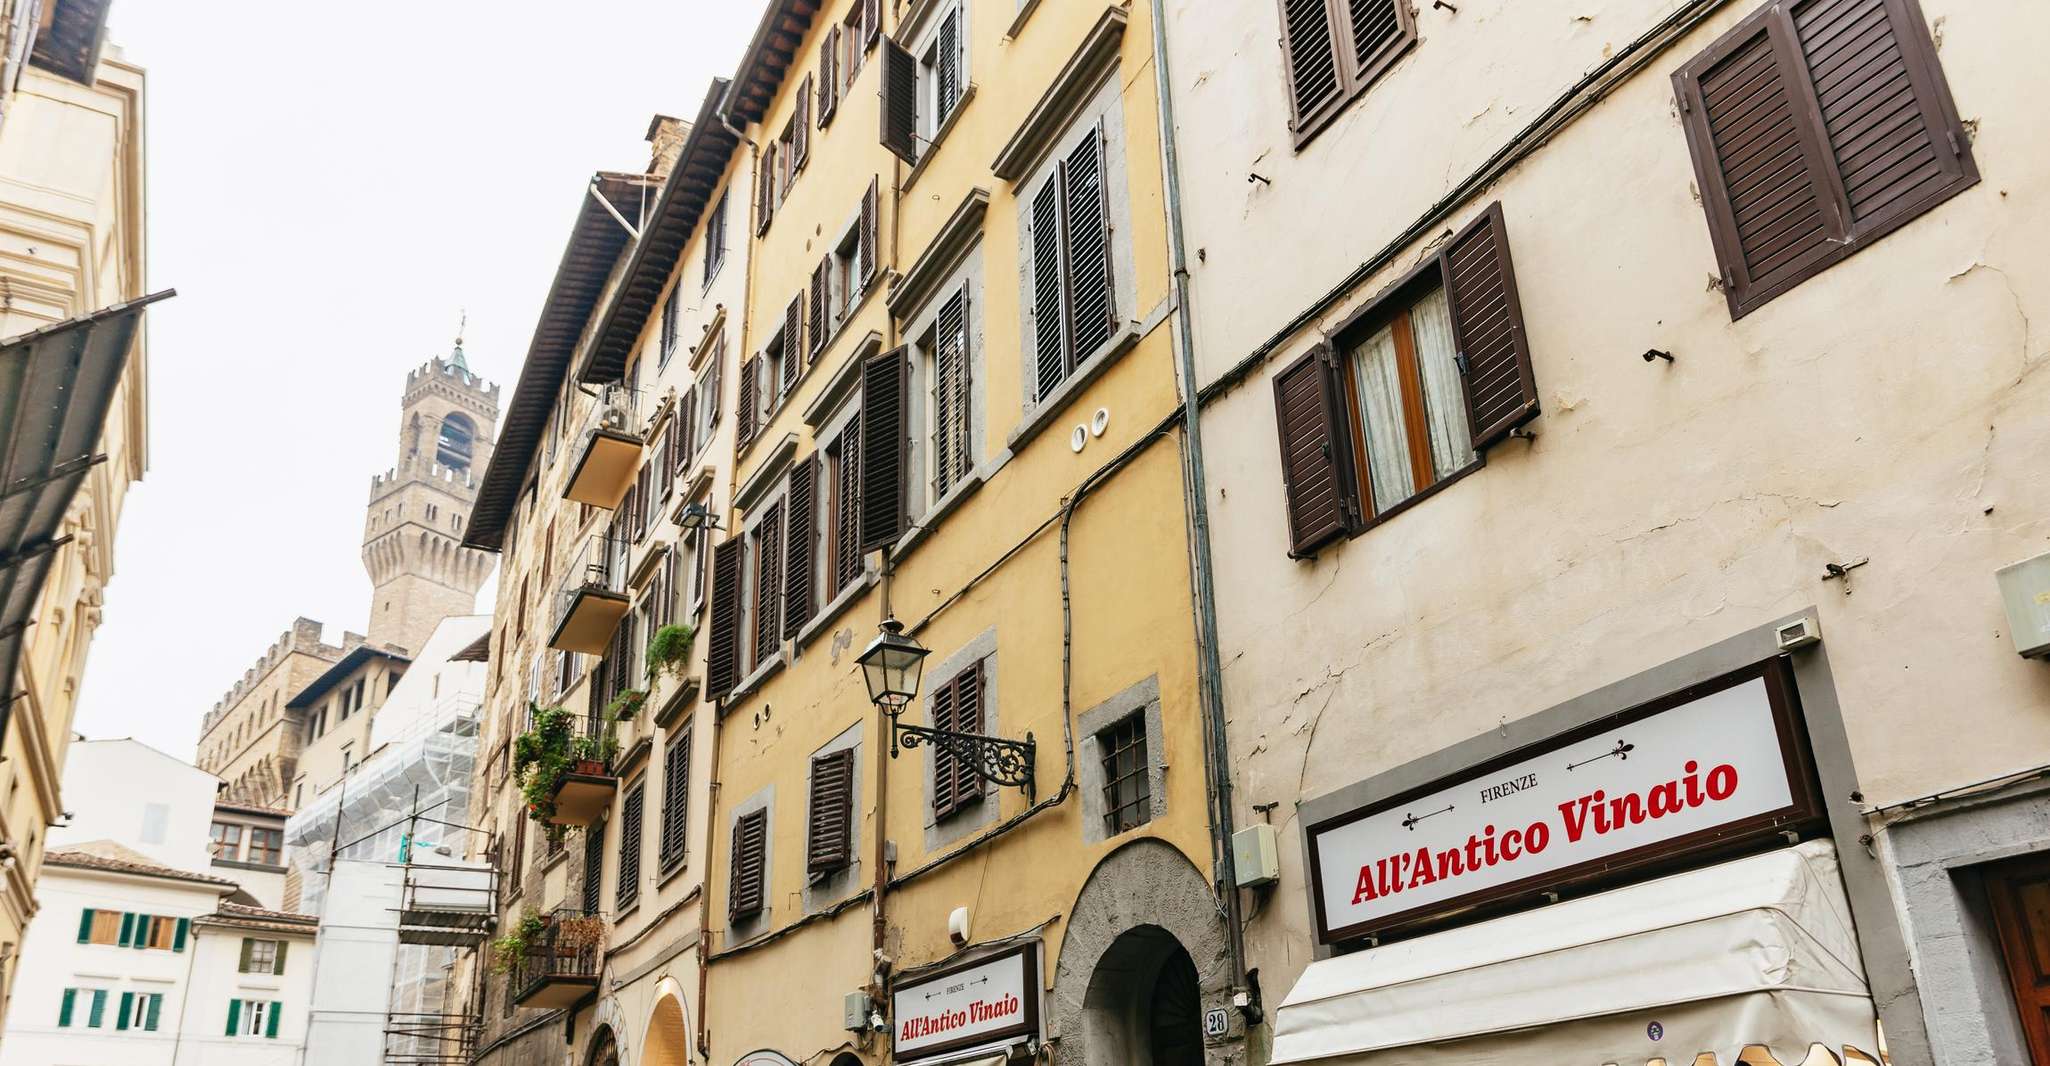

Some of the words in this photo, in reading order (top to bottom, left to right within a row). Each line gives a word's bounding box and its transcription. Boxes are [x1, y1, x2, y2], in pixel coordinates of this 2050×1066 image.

[1480, 773, 1538, 804] FIRENZE
[1351, 821, 1550, 905] All’Antico
[1557, 760, 1739, 843] Vinaio
[900, 1009, 966, 1041] All’Antico
[969, 993, 1019, 1024] Vinaio
[1209, 1013, 1225, 1033] 28
